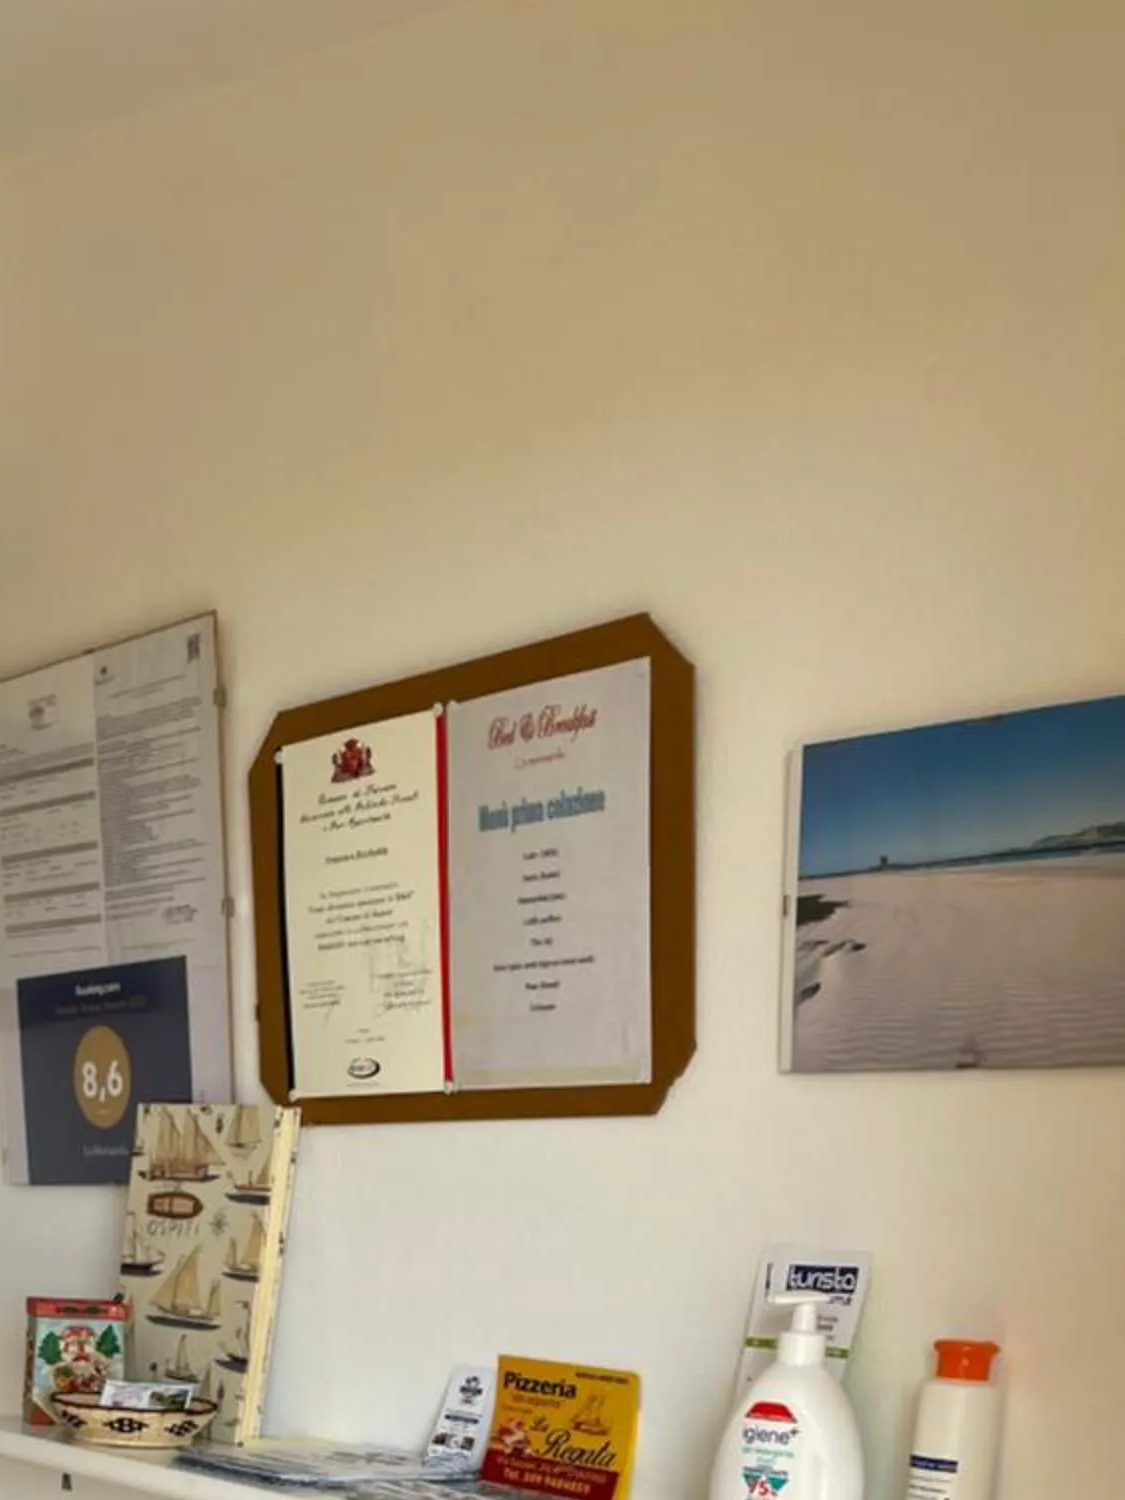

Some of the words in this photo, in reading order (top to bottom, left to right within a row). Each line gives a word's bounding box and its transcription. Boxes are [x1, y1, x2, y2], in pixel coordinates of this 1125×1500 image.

[487, 716, 517, 750] Bed
[511, 797, 544, 833] prima
[547, 786, 605, 820] colazione
[82, 1060, 123, 1103] 8,6
[504, 1371, 578, 1399] Pizzeria
